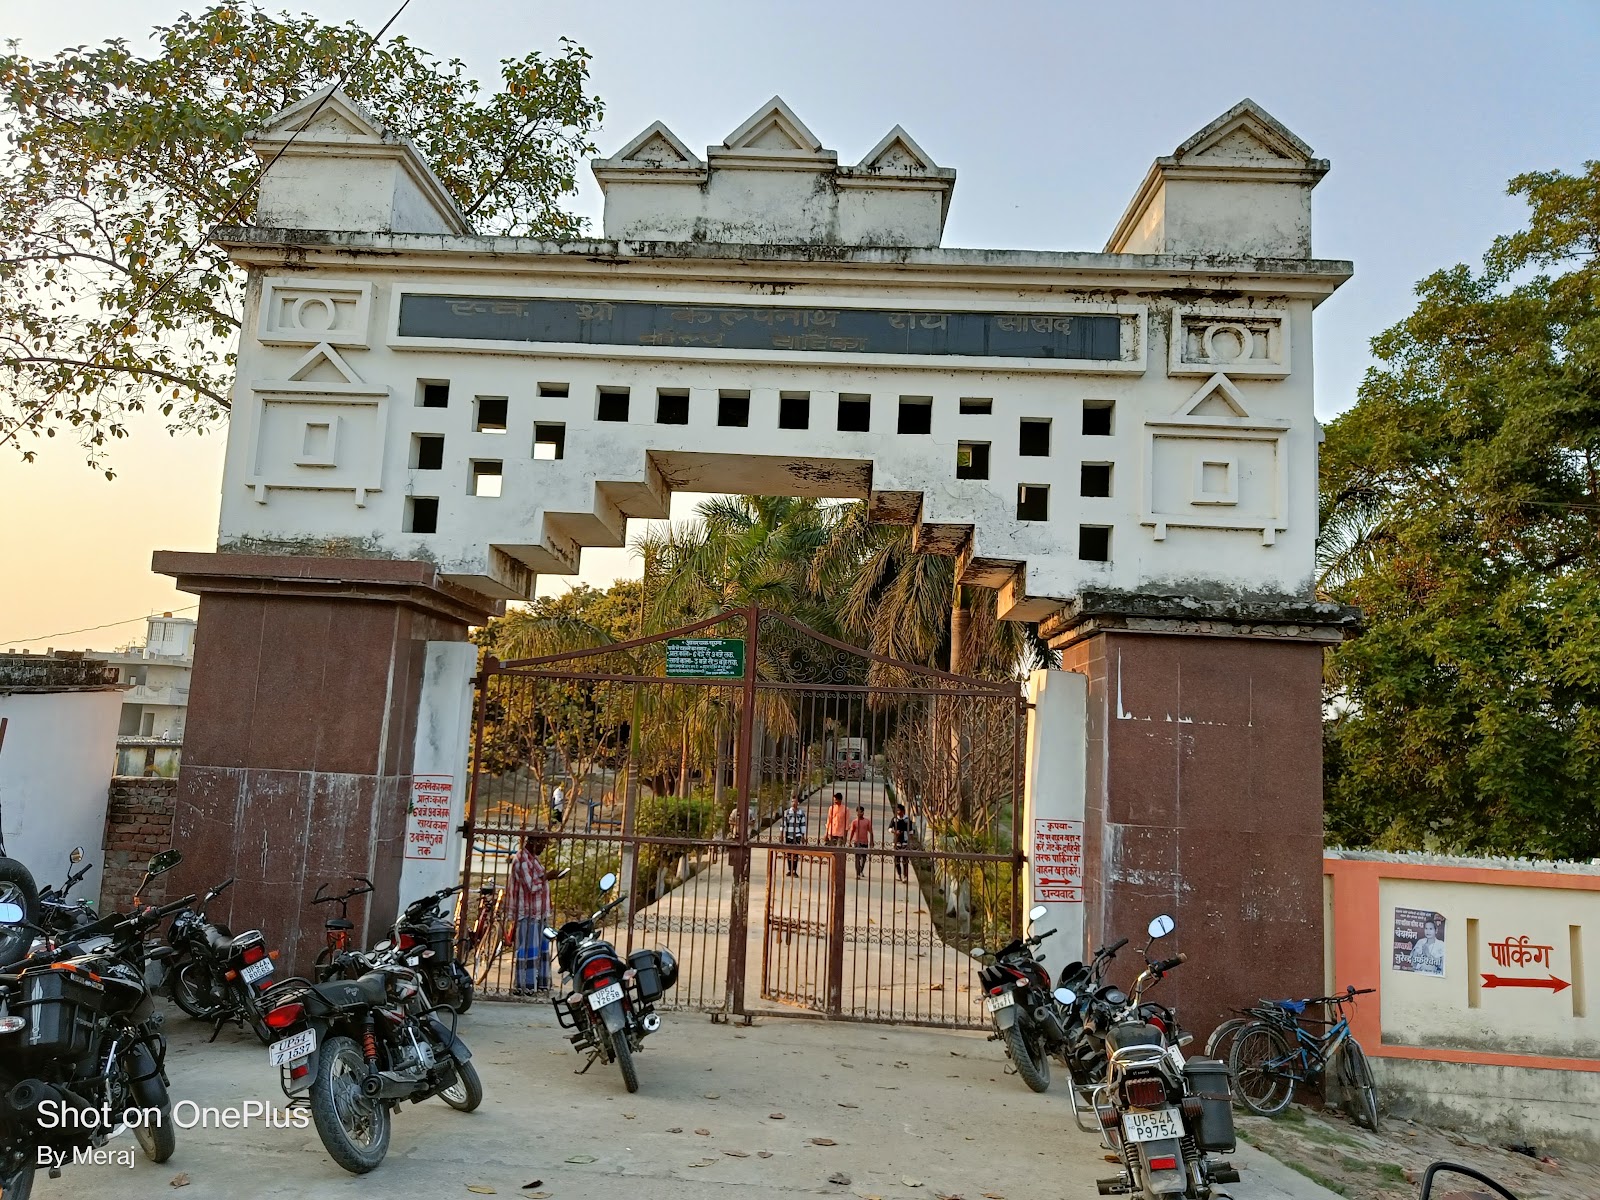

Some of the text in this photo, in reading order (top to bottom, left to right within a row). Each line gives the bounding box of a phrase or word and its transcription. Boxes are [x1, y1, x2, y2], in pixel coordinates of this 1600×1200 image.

[887, 311, 951, 330] राय
[418, 846, 431, 855] तक
[1041, 889, 1075, 900] धन्यवाद
[1488, 935, 1554, 969] पार्किंग
[279, 1034, 307, 1051] UP54
[288, 1043, 312, 1059] 1537
[1133, 1111, 1174, 1127] UP54A
[1136, 1124, 1178, 1140] P9754
